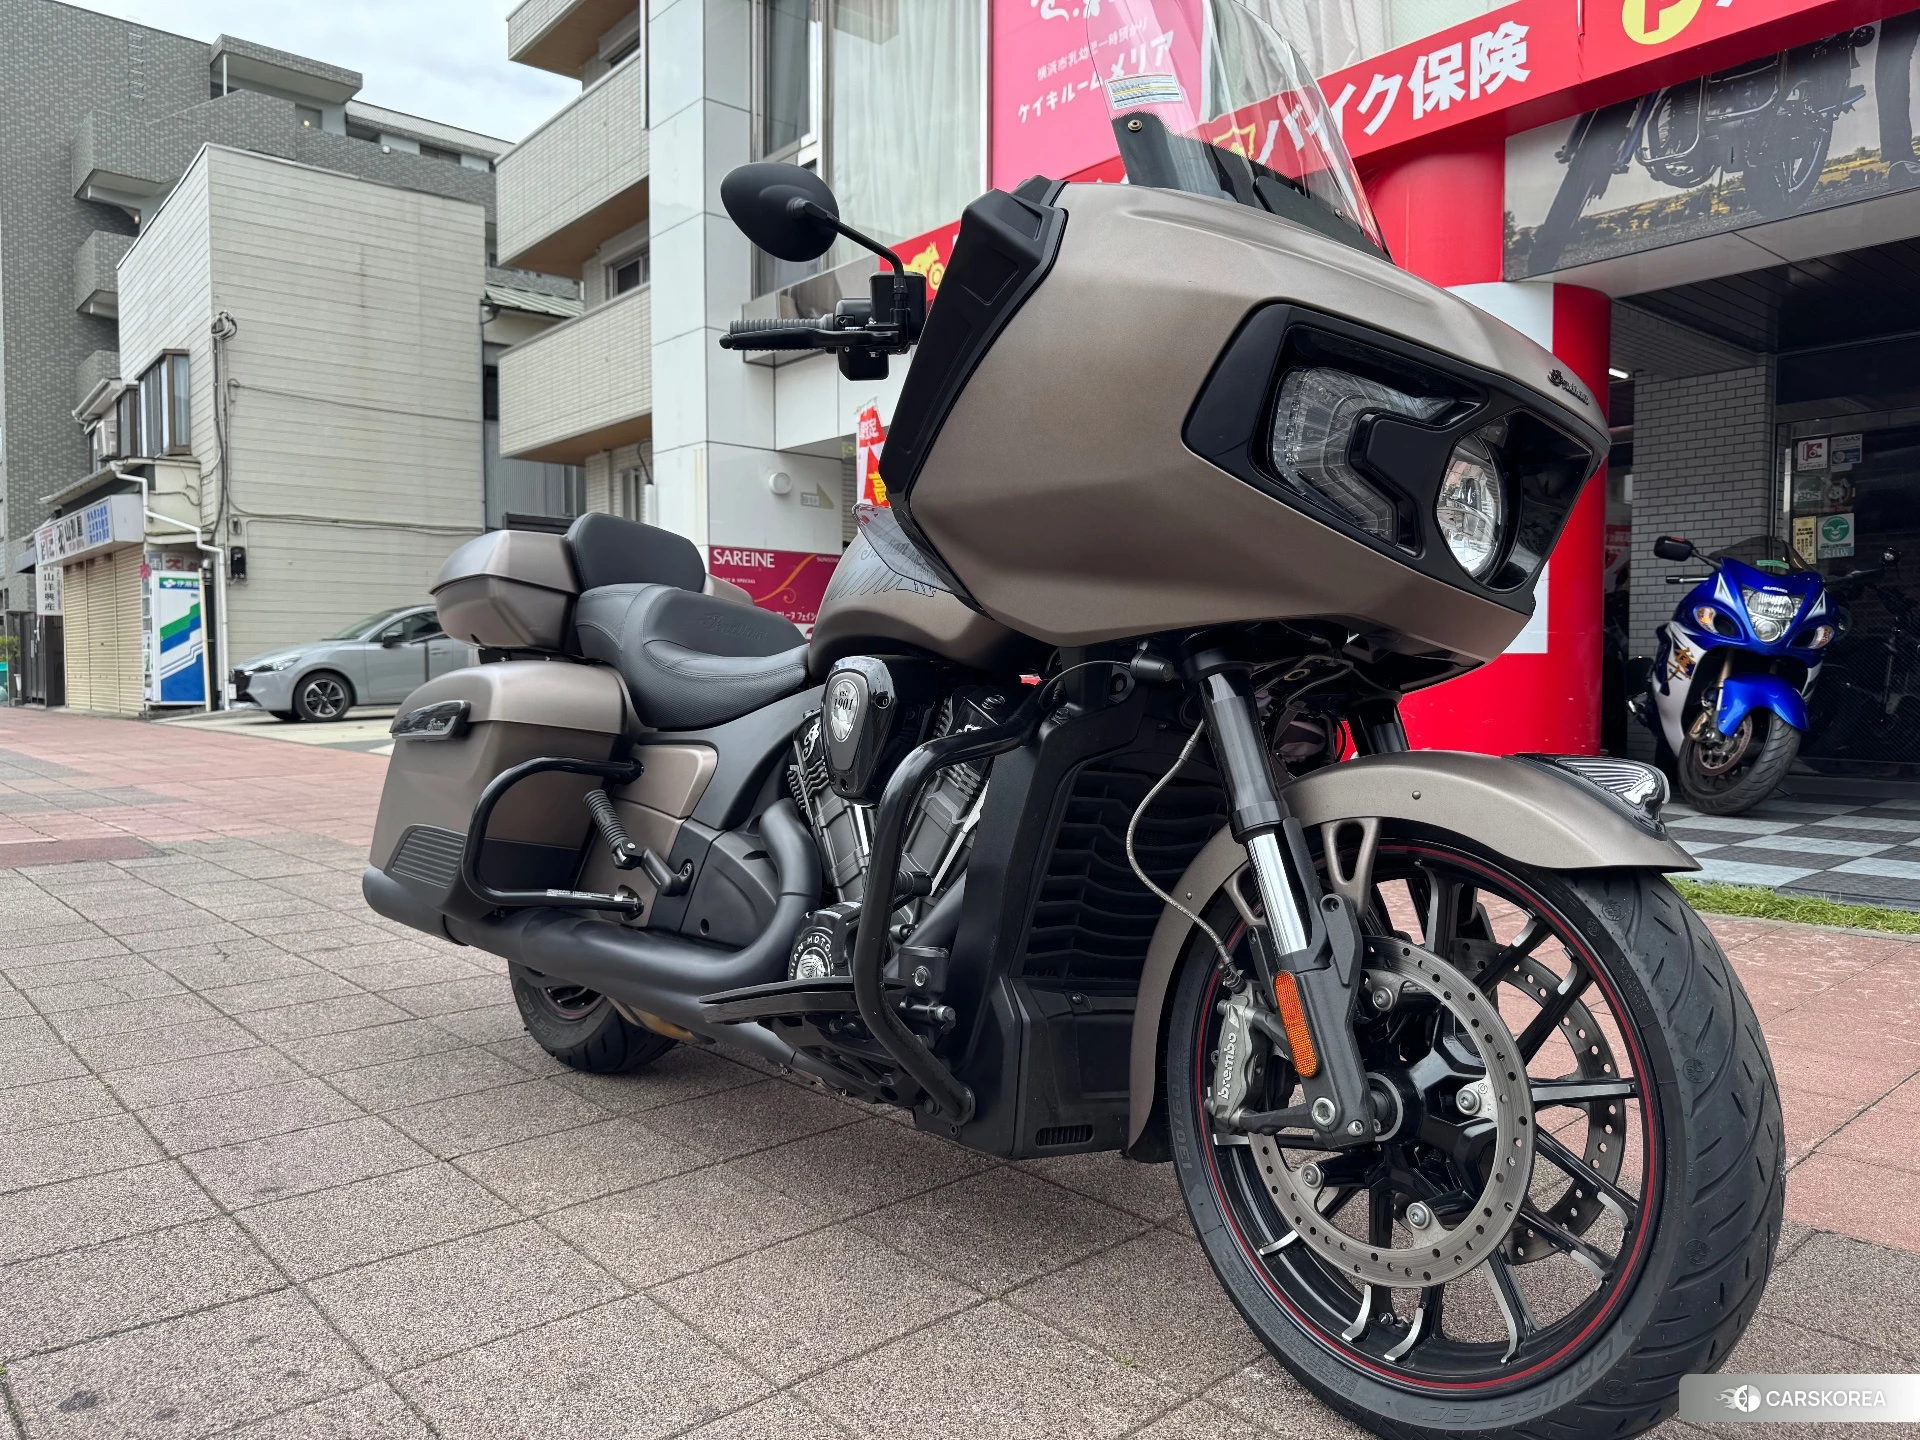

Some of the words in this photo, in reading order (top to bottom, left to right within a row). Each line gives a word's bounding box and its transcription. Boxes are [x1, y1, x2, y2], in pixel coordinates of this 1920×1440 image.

[713, 549, 775, 568] SAREINE
[834, 698, 854, 710] 1901
[1217, 1032, 1237, 1100] brembo
